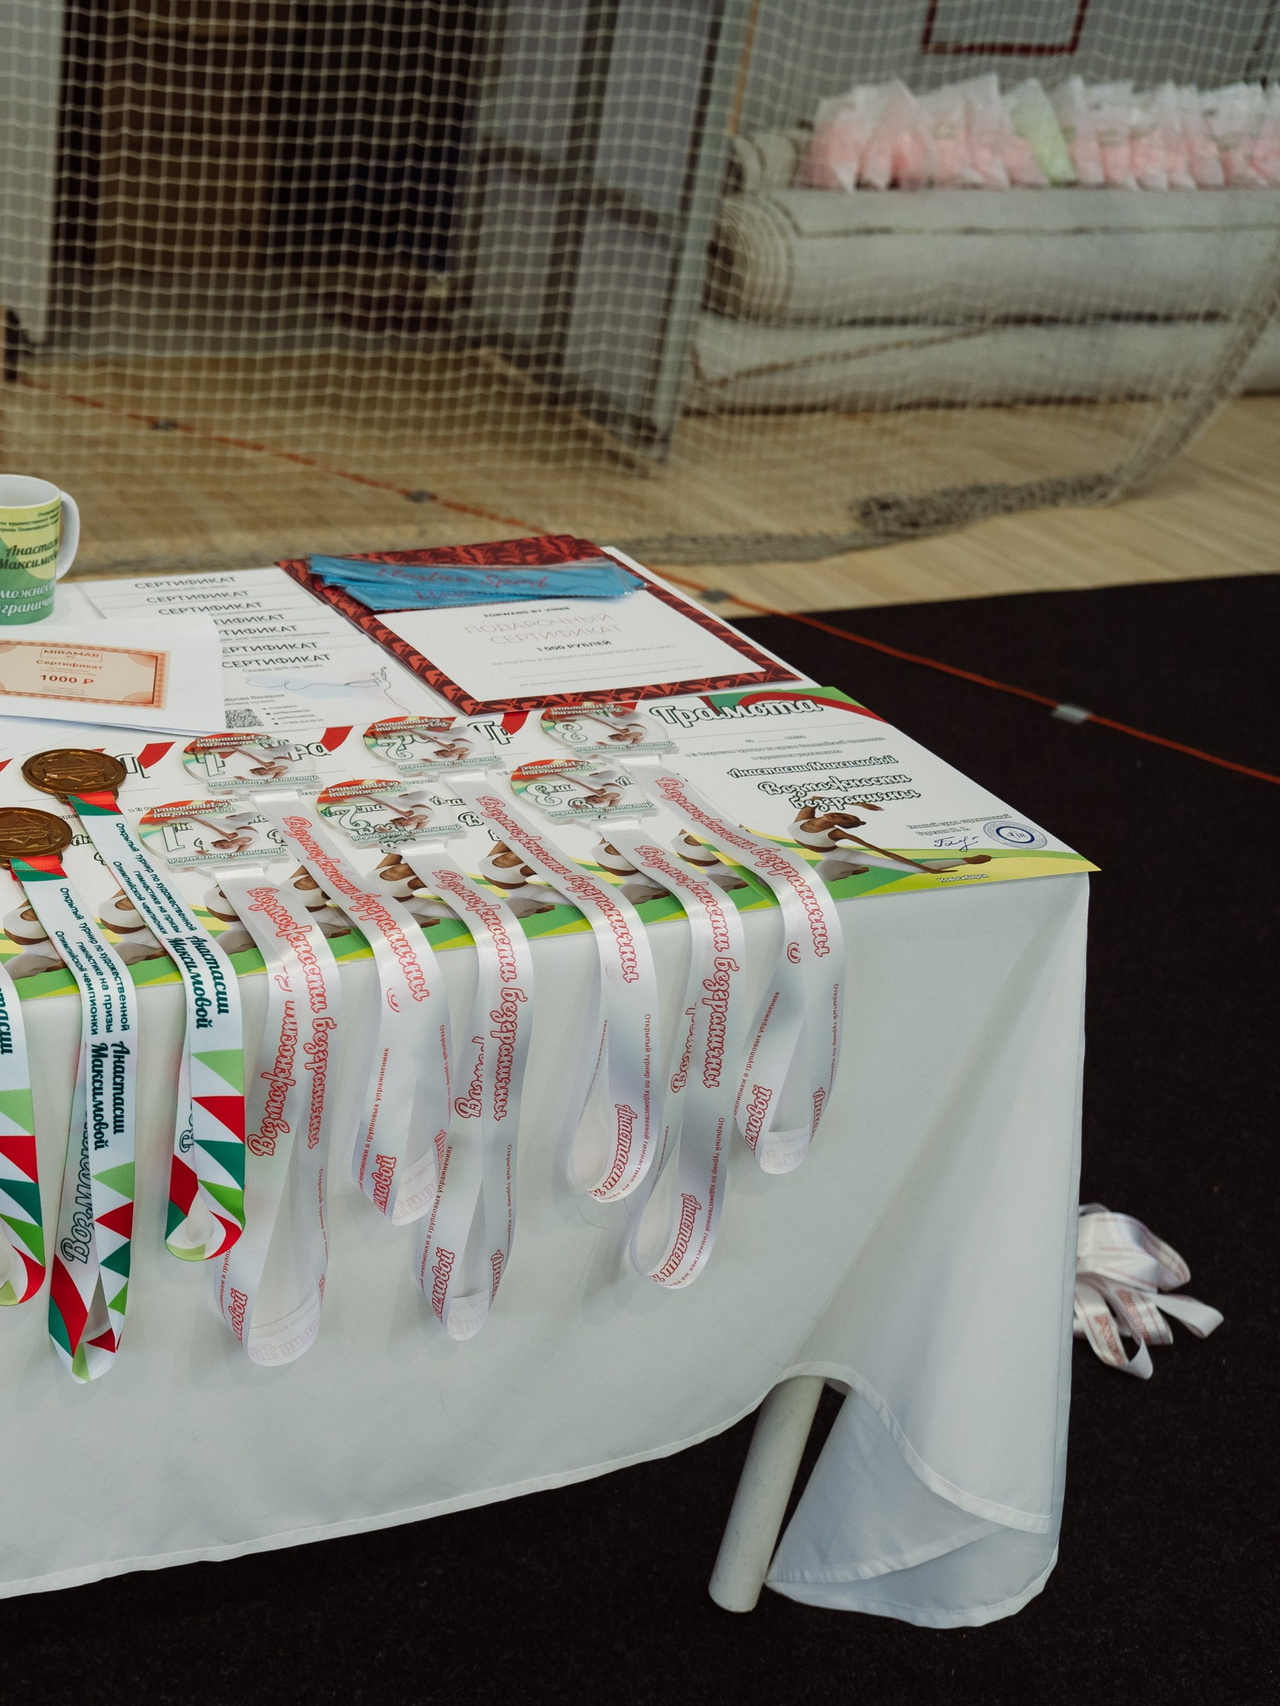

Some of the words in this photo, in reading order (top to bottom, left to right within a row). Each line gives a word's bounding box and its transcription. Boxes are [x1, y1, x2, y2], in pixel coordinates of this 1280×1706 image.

[134, 576, 236, 589] СЕРТИФИКАТ
[146, 590, 249, 604] СЕРТИФИКАТ
[158, 602, 262, 616] СЕРТИФИКАТ
[214, 613, 285, 626] ТИФИКАТ
[464, 612, 614, 634] ПОДАРОЧНЫЙ
[218, 625, 298, 637] ТИФИКАТ
[490, 624, 622, 645] СЕРТИФИКАТ
[567, 640, 612, 649] РУБЛЕЙ
[222, 642, 318, 654] ЕРТИФИКАТ
[222, 654, 330, 668] СЕРТИФИКАТ
[36, 660, 102, 670] Сертификат
[40, 674, 77, 683] 1000
[649, 698, 824, 728] Грамота
[727, 765, 810, 778] Анастасии
[807, 754, 899, 771] Максимовой
[757, 773, 912, 797] Возможности
[789, 789, 921, 812] безграничны
[656, 777, 758, 849] Возможности
[751, 848, 830, 957] безграничны
[477, 796, 572, 875] Возможности
[563, 875, 639, 983] безграничны
[282, 816, 361, 895] Возможности
[349, 894, 430, 1001] безграничны
[60, 887, 83, 920] Открытый
[79, 923, 97, 944] турнир
[97, 952, 130, 1031] художественной
[76, 941, 103, 975] гимнастике
[635, 846, 730, 952] Возможности
[702, 957, 739, 1088] безграничны
[55, 931, 86, 972] Олимпийской
[82, 973, 99, 1035] чемпионки
[99, 978, 109, 990] на
[166, 938, 213, 1029] Максимовой
[186, 936, 229, 1014] Анастасии
[432, 870, 518, 982] Возможности
[490, 987, 528, 1121] безграничны
[102, 995, 114, 1033] призы
[247, 887, 328, 1013] Возможности
[304, 1017, 337, 1149] безграничны
[91, 1044, 109, 1150] Максимовой
[111, 1041, 130, 1134] Анастасии
[602, 1104, 638, 1190] Анастасии
[659, 1193, 701, 1277] Анастасии
